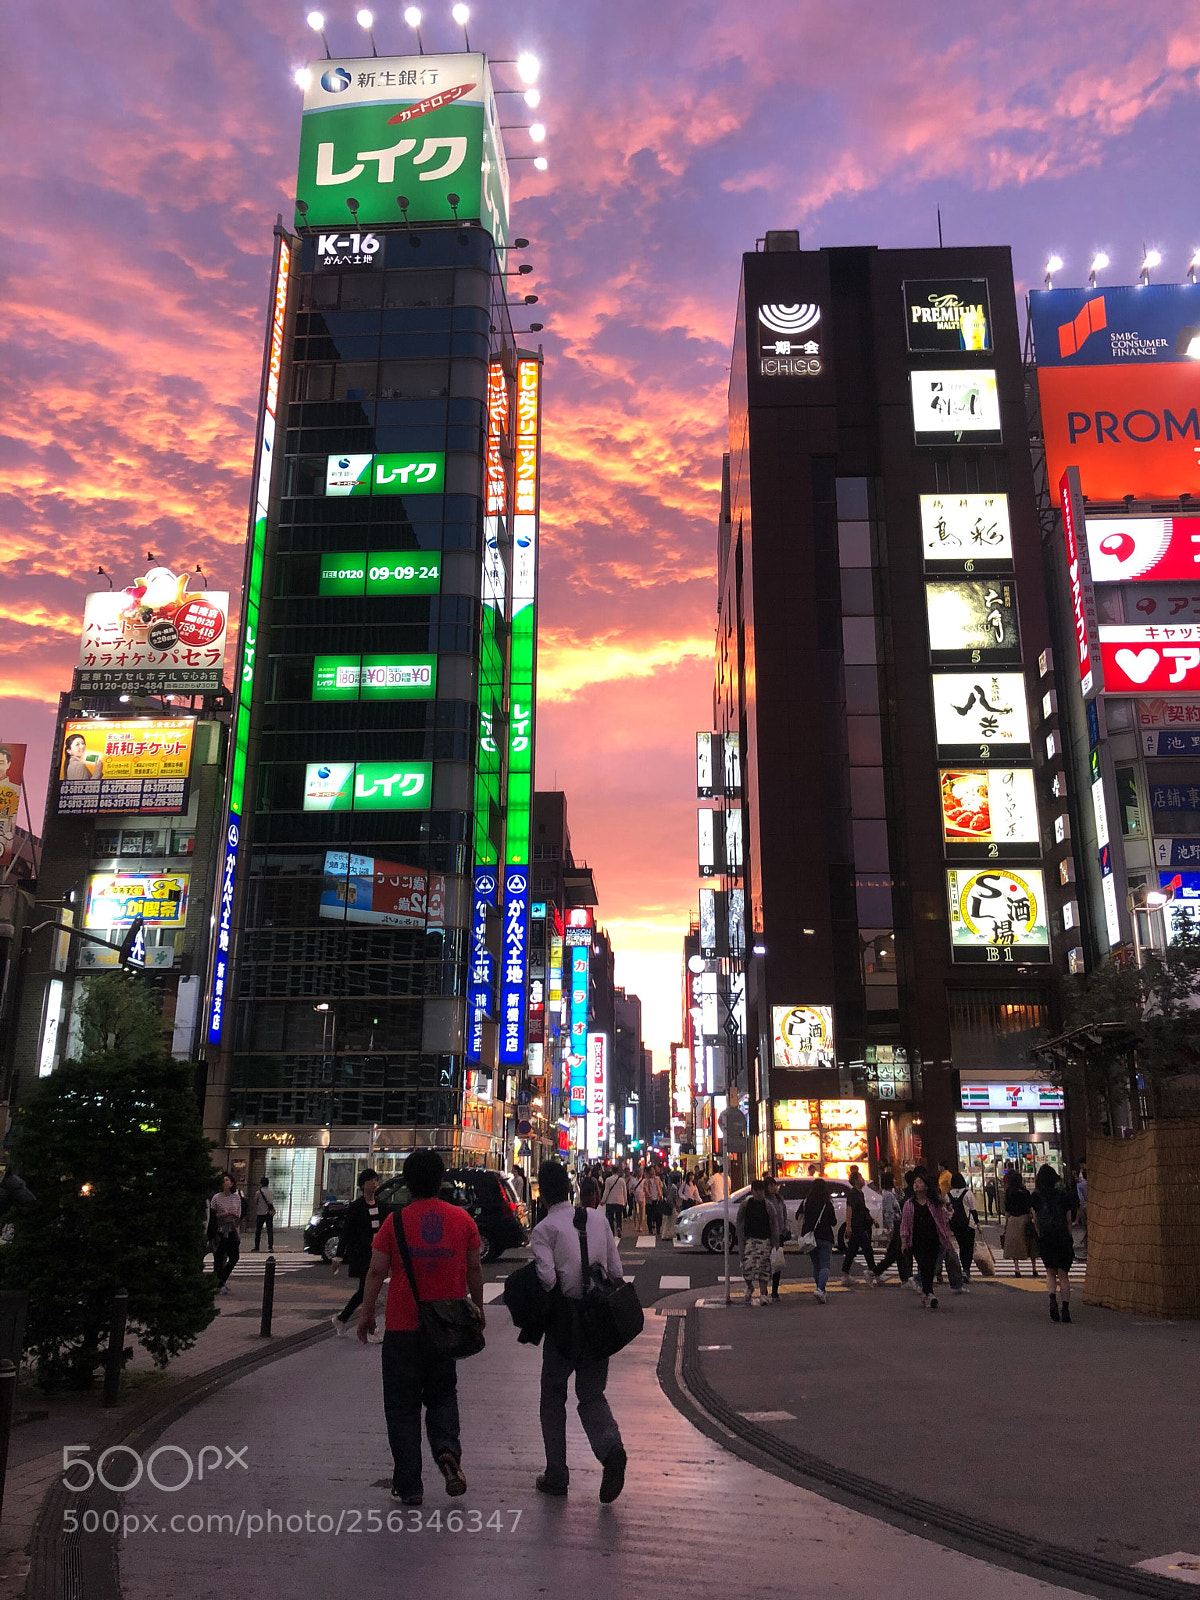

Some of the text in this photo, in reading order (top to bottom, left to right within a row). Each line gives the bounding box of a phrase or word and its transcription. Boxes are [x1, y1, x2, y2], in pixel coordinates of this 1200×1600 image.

[357, 69, 438, 88] 新生銀行
[400, 86, 462, 122] カードローン
[315, 136, 467, 186] レイク
[317, 233, 380, 255] K-16
[323, 255, 373, 265] かんべ土地
[1110, 332, 1139, 341] SMBC
[1111, 338, 1169, 349] CONSUMER
[762, 341, 819, 355] 一期一会
[1112, 347, 1157, 357] FINANCE
[761, 359, 821, 375] ICHIGO
[516, 361, 537, 512] にしだクリニック新橋
[376, 463, 437, 484] レイク
[338, 569, 364, 579] 0120
[369, 566, 439, 580] 09-09-24
[86, 620, 148, 634] ハニトー
[177, 621, 215, 639] 759-418
[196, 617, 216, 627] 0120
[1072, 580, 1088, 664] アイフル
[84, 637, 147, 651] パーティー
[84, 649, 222, 667] カラオケもパセラ
[244, 626, 256, 682] レイク
[339, 673, 355, 683] 180
[367, 668, 386, 683] ¥0
[388, 673, 401, 682] 30
[412, 667, 430, 682] ¥0
[511, 704, 529, 752] レイク
[105, 741, 188, 755] 新和チケット
[979, 744, 990, 758] 2
[356, 773, 424, 797] レイク
[988, 843, 998, 857] 2
[219, 853, 236, 951] かんべ土地
[508, 900, 524, 984] かんべ土地
[506, 993, 519, 1052] 新橋支店
[571, 958, 588, 1101] カラオケ館
